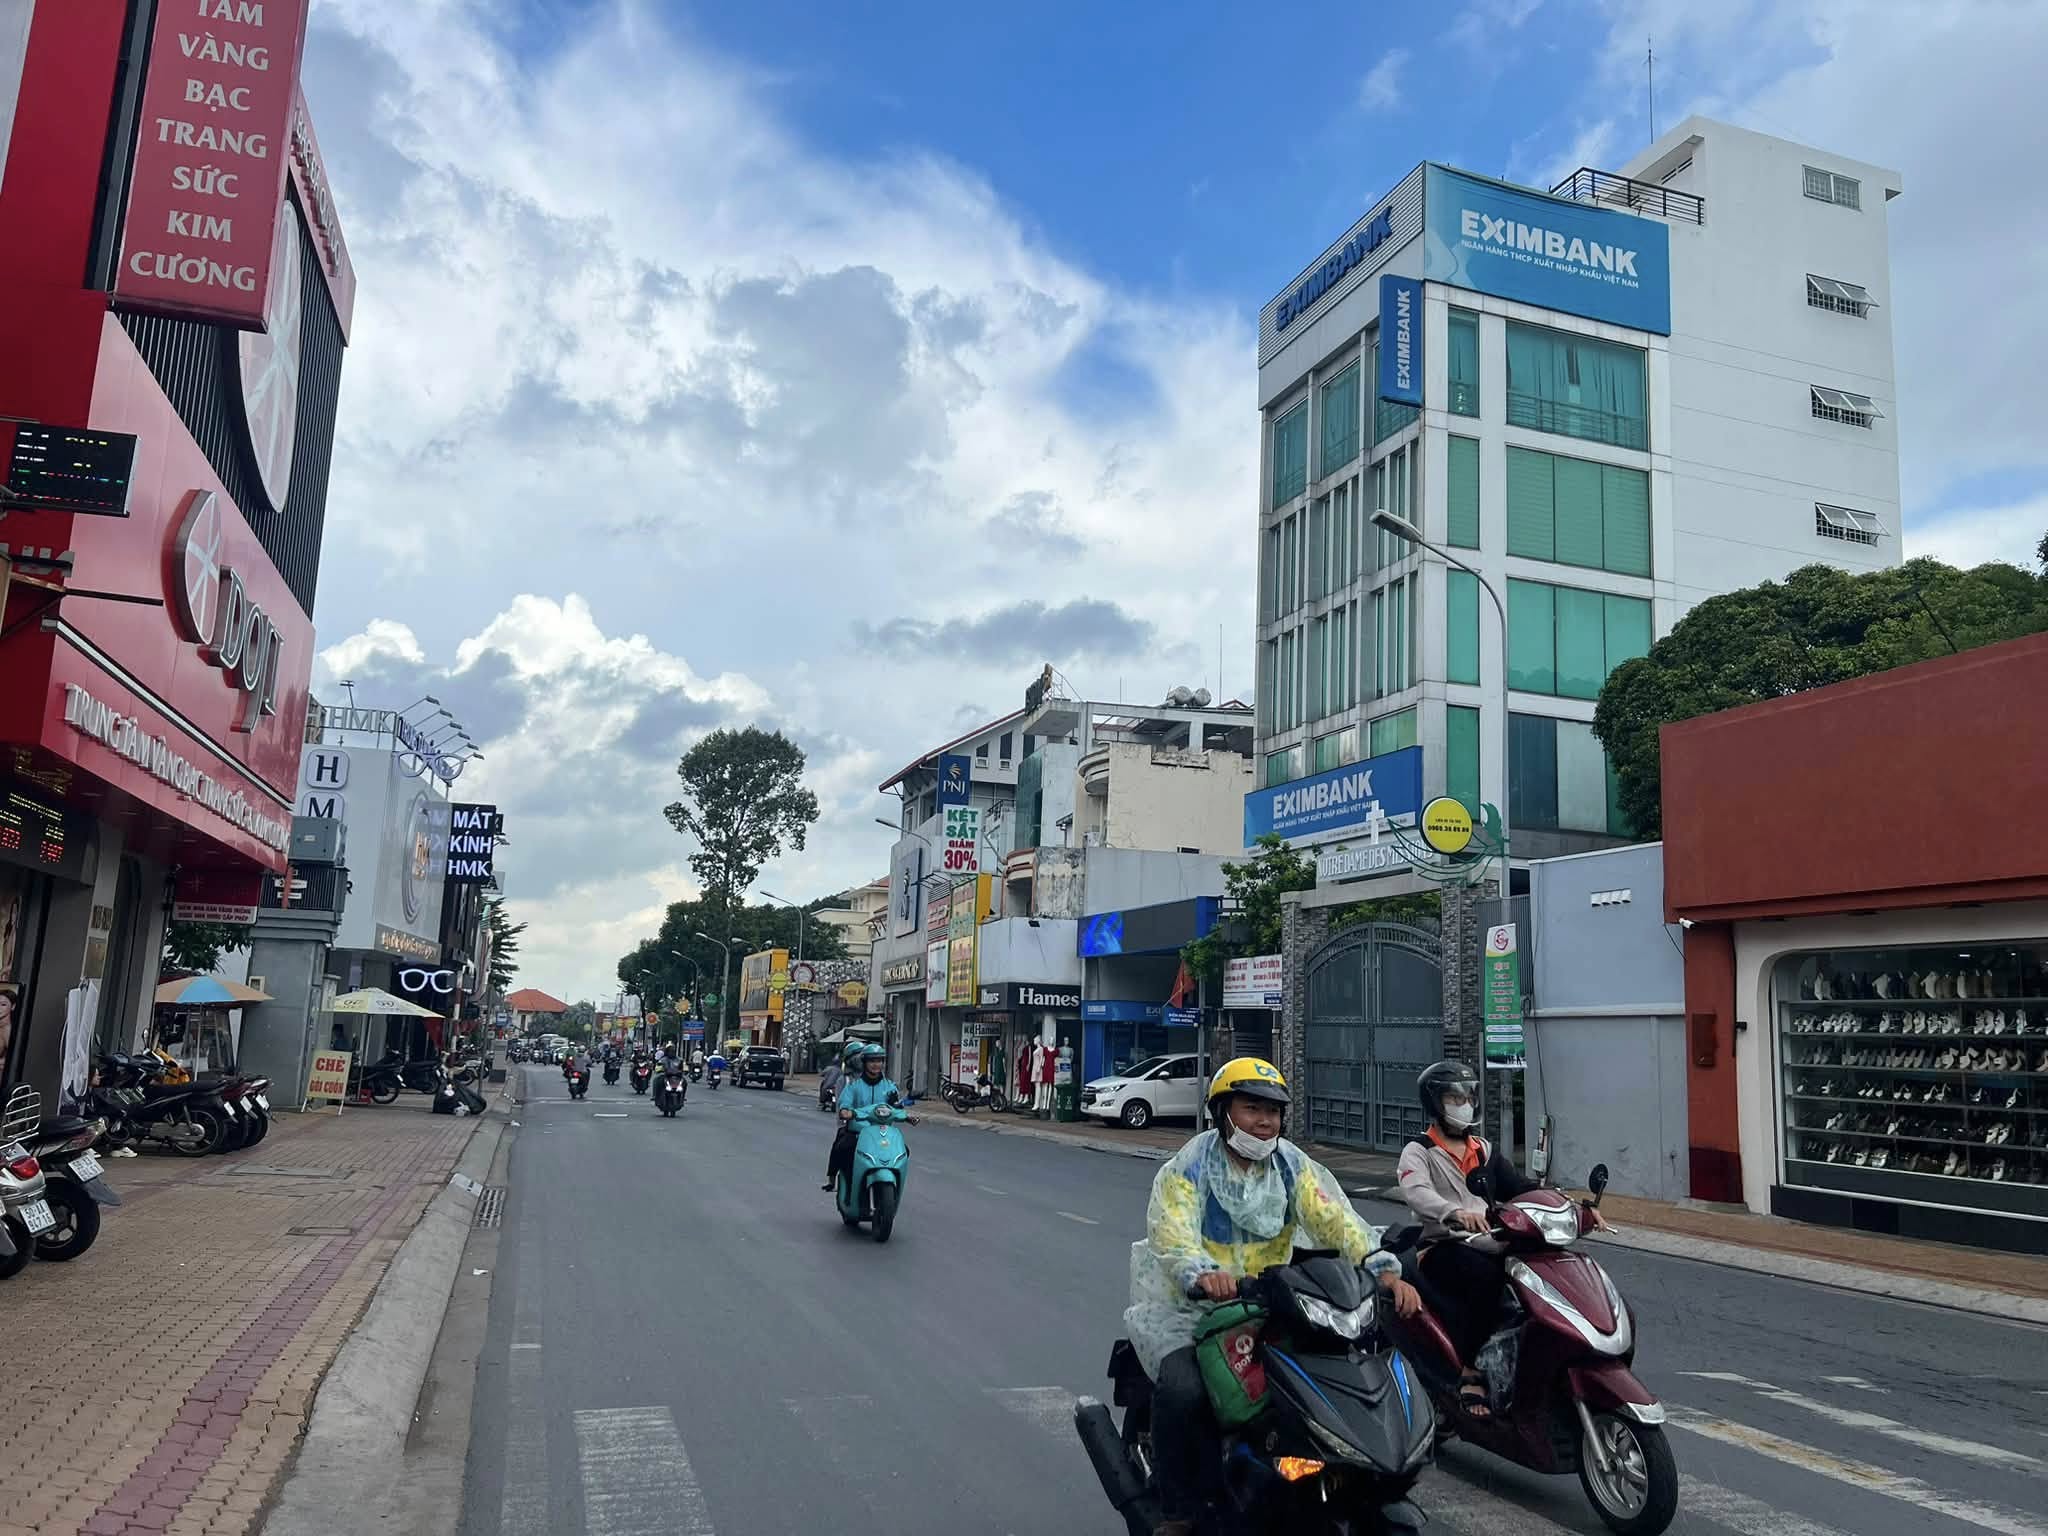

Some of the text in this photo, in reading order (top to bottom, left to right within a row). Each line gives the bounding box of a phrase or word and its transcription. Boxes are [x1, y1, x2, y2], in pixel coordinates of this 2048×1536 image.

[178, 32, 269, 71] VÀNG
[185, 78, 251, 112] BẠC
[155, 118, 267, 158] TRANG
[172, 164, 239, 198] SỨC
[167, 209, 232, 243] KIM
[1461, 208, 1638, 277] EXIMBANK
[129, 250, 256, 291] CƯƠNG
[1276, 206, 1394, 332] EXIMBANK
[1461, 239, 1639, 289] NGÂN HÀNG TMCP XUẤT NHẬP KHẨU VIỆT NAM
[1397, 288, 1411, 391] EXIMBANK
[64, 683, 121, 750] TRUNG
[118, 716, 151, 768] TÂM
[328, 706, 393, 733] HMK
[943, 780, 966, 797] PNJ
[1273, 769, 1374, 820] EXIMBANK
[946, 822, 978, 839] SẮT
[947, 807, 979, 823] KÉT
[449, 830, 493, 855] KÍNH
[948, 838, 975, 848] GIẢM
[1344, 849, 1368, 873] DAME
[1368, 846, 1386, 870] DES
[447, 859, 491, 879] HMK
[944, 849, 978, 871] 30%
[1018, 987, 1080, 1007] Hames
